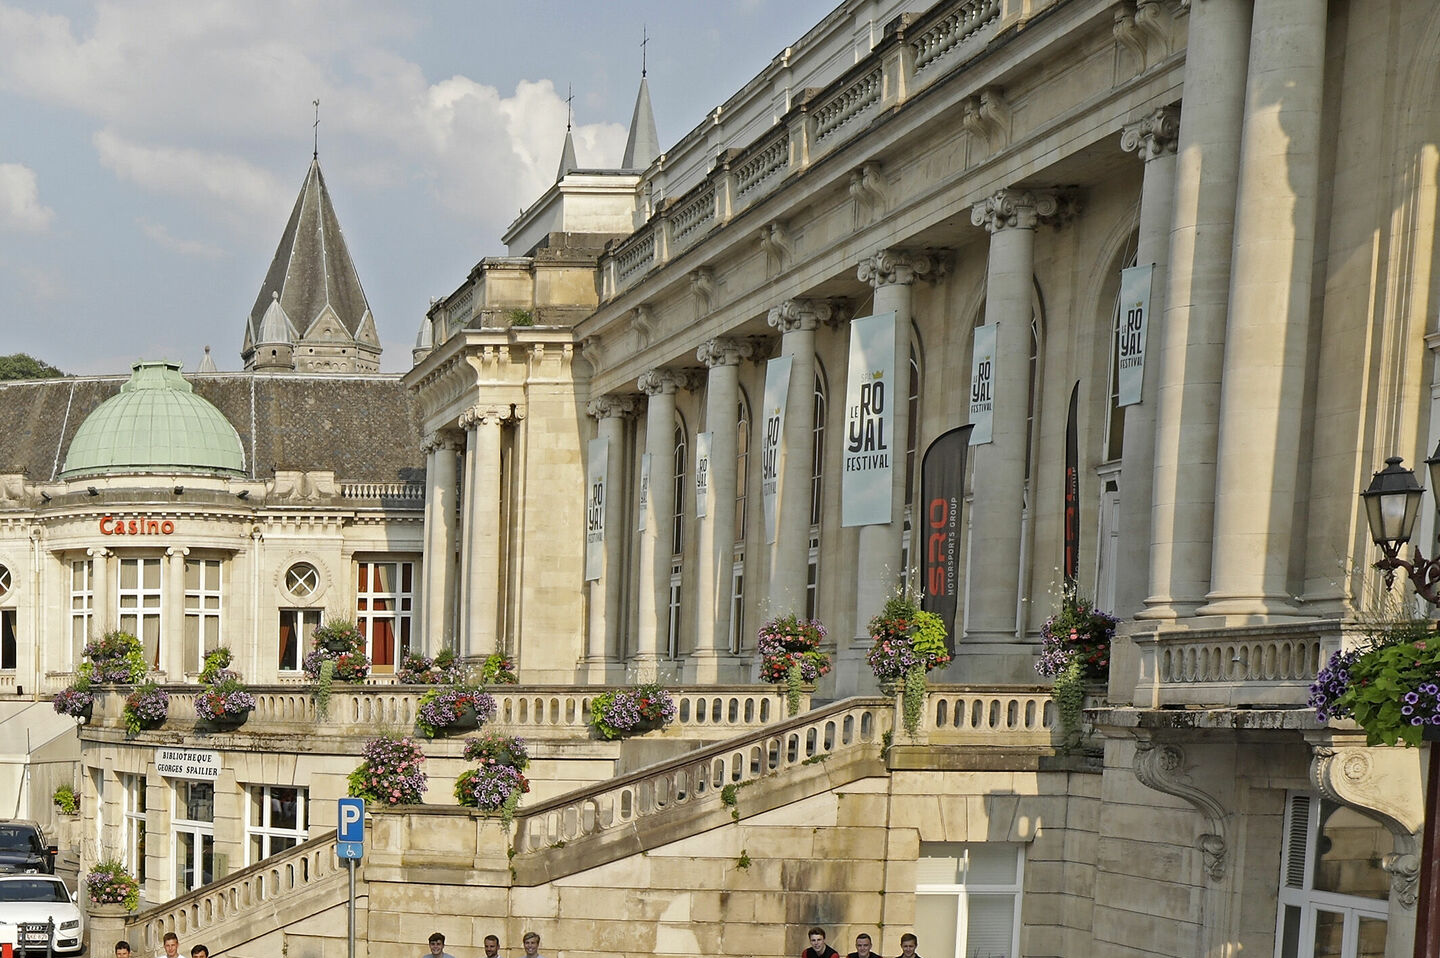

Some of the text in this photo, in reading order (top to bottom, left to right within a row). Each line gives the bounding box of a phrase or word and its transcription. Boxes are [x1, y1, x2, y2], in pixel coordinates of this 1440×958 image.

[1120, 357, 1143, 370] FESTIVAL
[850, 405, 858, 418] LE
[971, 403, 992, 413] FESTIVAL
[846, 454, 889, 472] FESTIVAL
[100, 516, 175, 536] Casino
[929, 498, 948, 597] SRO
[948, 532, 956, 597] MOTORSPORTS
[162, 751, 212, 763] BIBLIOTHEQUE
[157, 763, 218, 776] GEORGES SPAILIER
[341, 804, 359, 836] P
